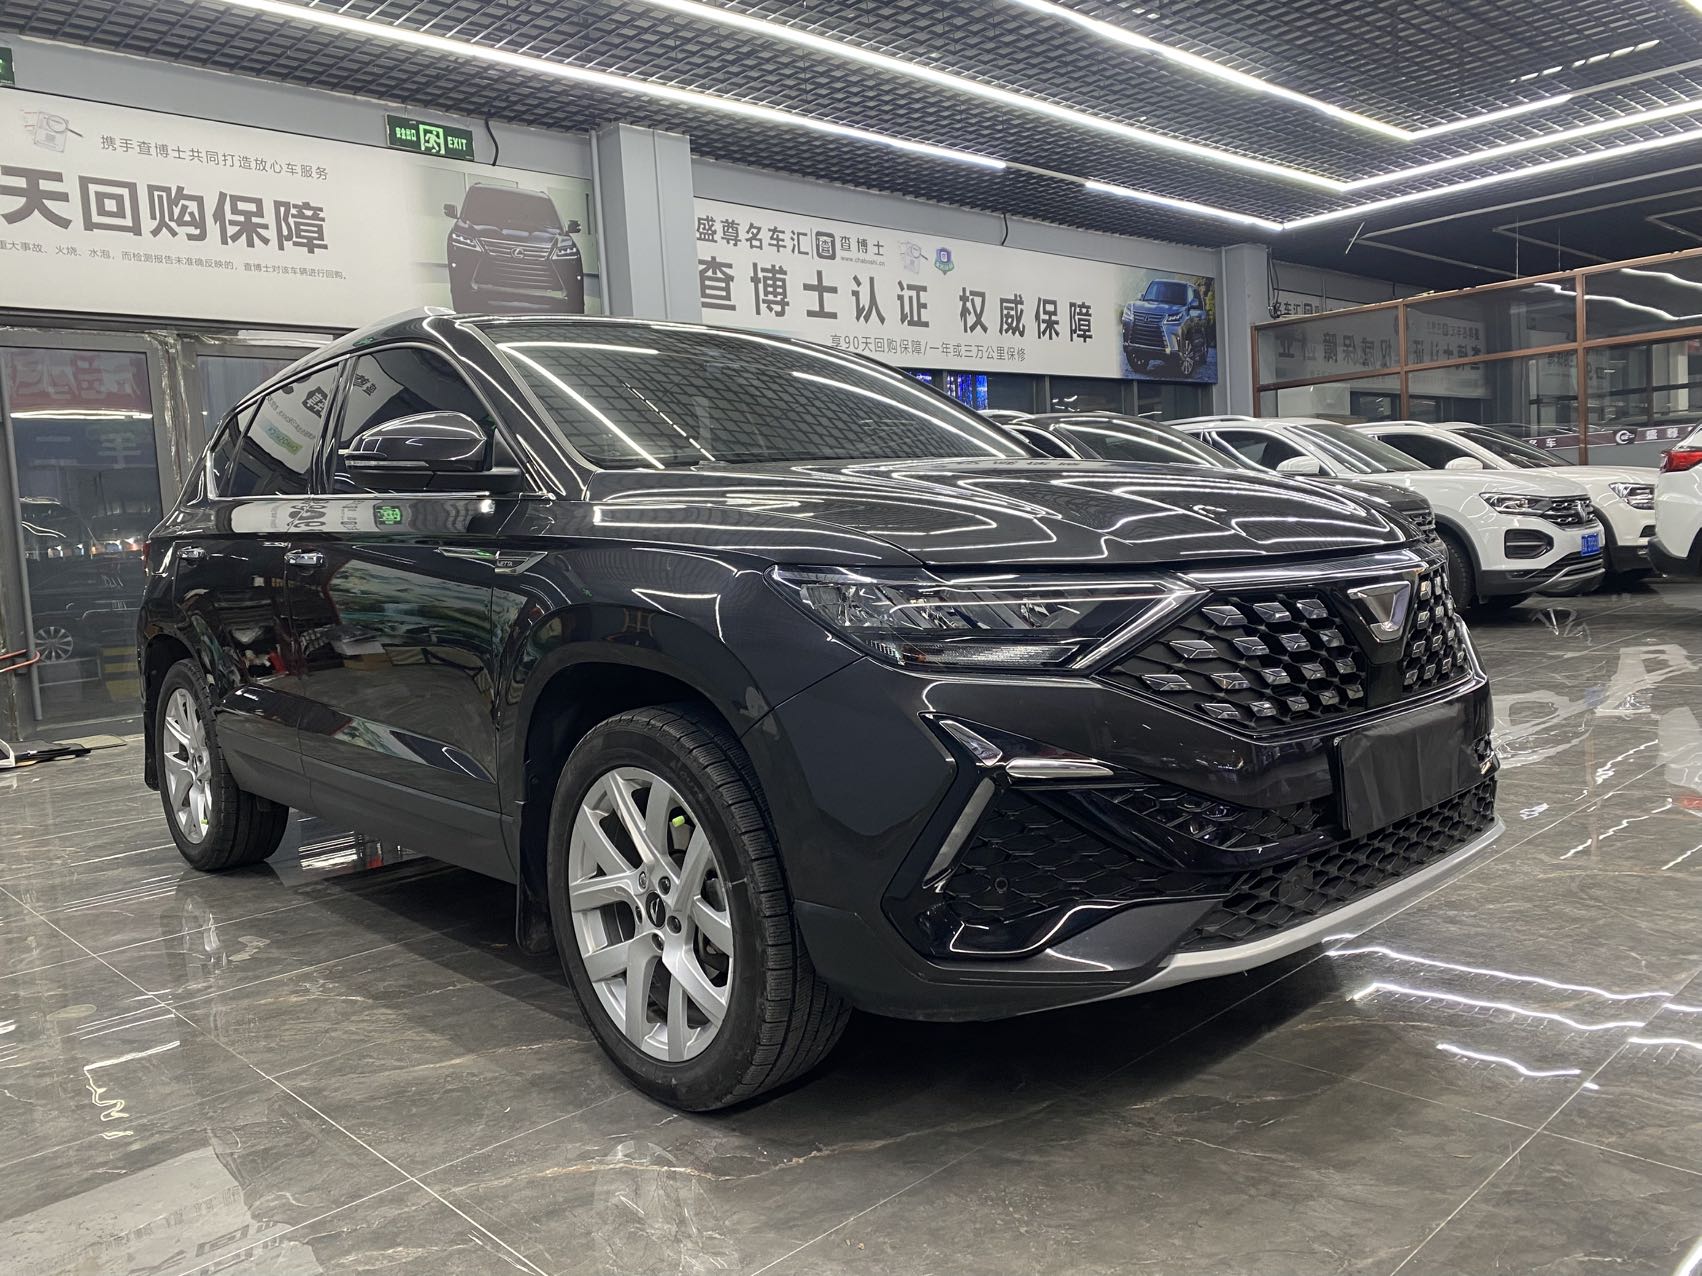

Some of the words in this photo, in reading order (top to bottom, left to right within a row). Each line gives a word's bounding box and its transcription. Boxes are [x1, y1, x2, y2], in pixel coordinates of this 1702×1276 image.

[100, 134, 328, 181] 携手查博士共同打造放心车服务
[447, 136, 467, 150] EXIT
[0, 164, 328, 254] 天回购保障
[696, 215, 810, 256] 盛尊名车汇
[840, 235, 884, 256] 查博士
[840, 256, 886, 267] www.chaboshi.cn
[698, 256, 930, 328] 查博士认证
[959, 287, 1093, 343] 权威保障
[830, 334, 1026, 362] 享90天回购保障/一年或三万公里保修
